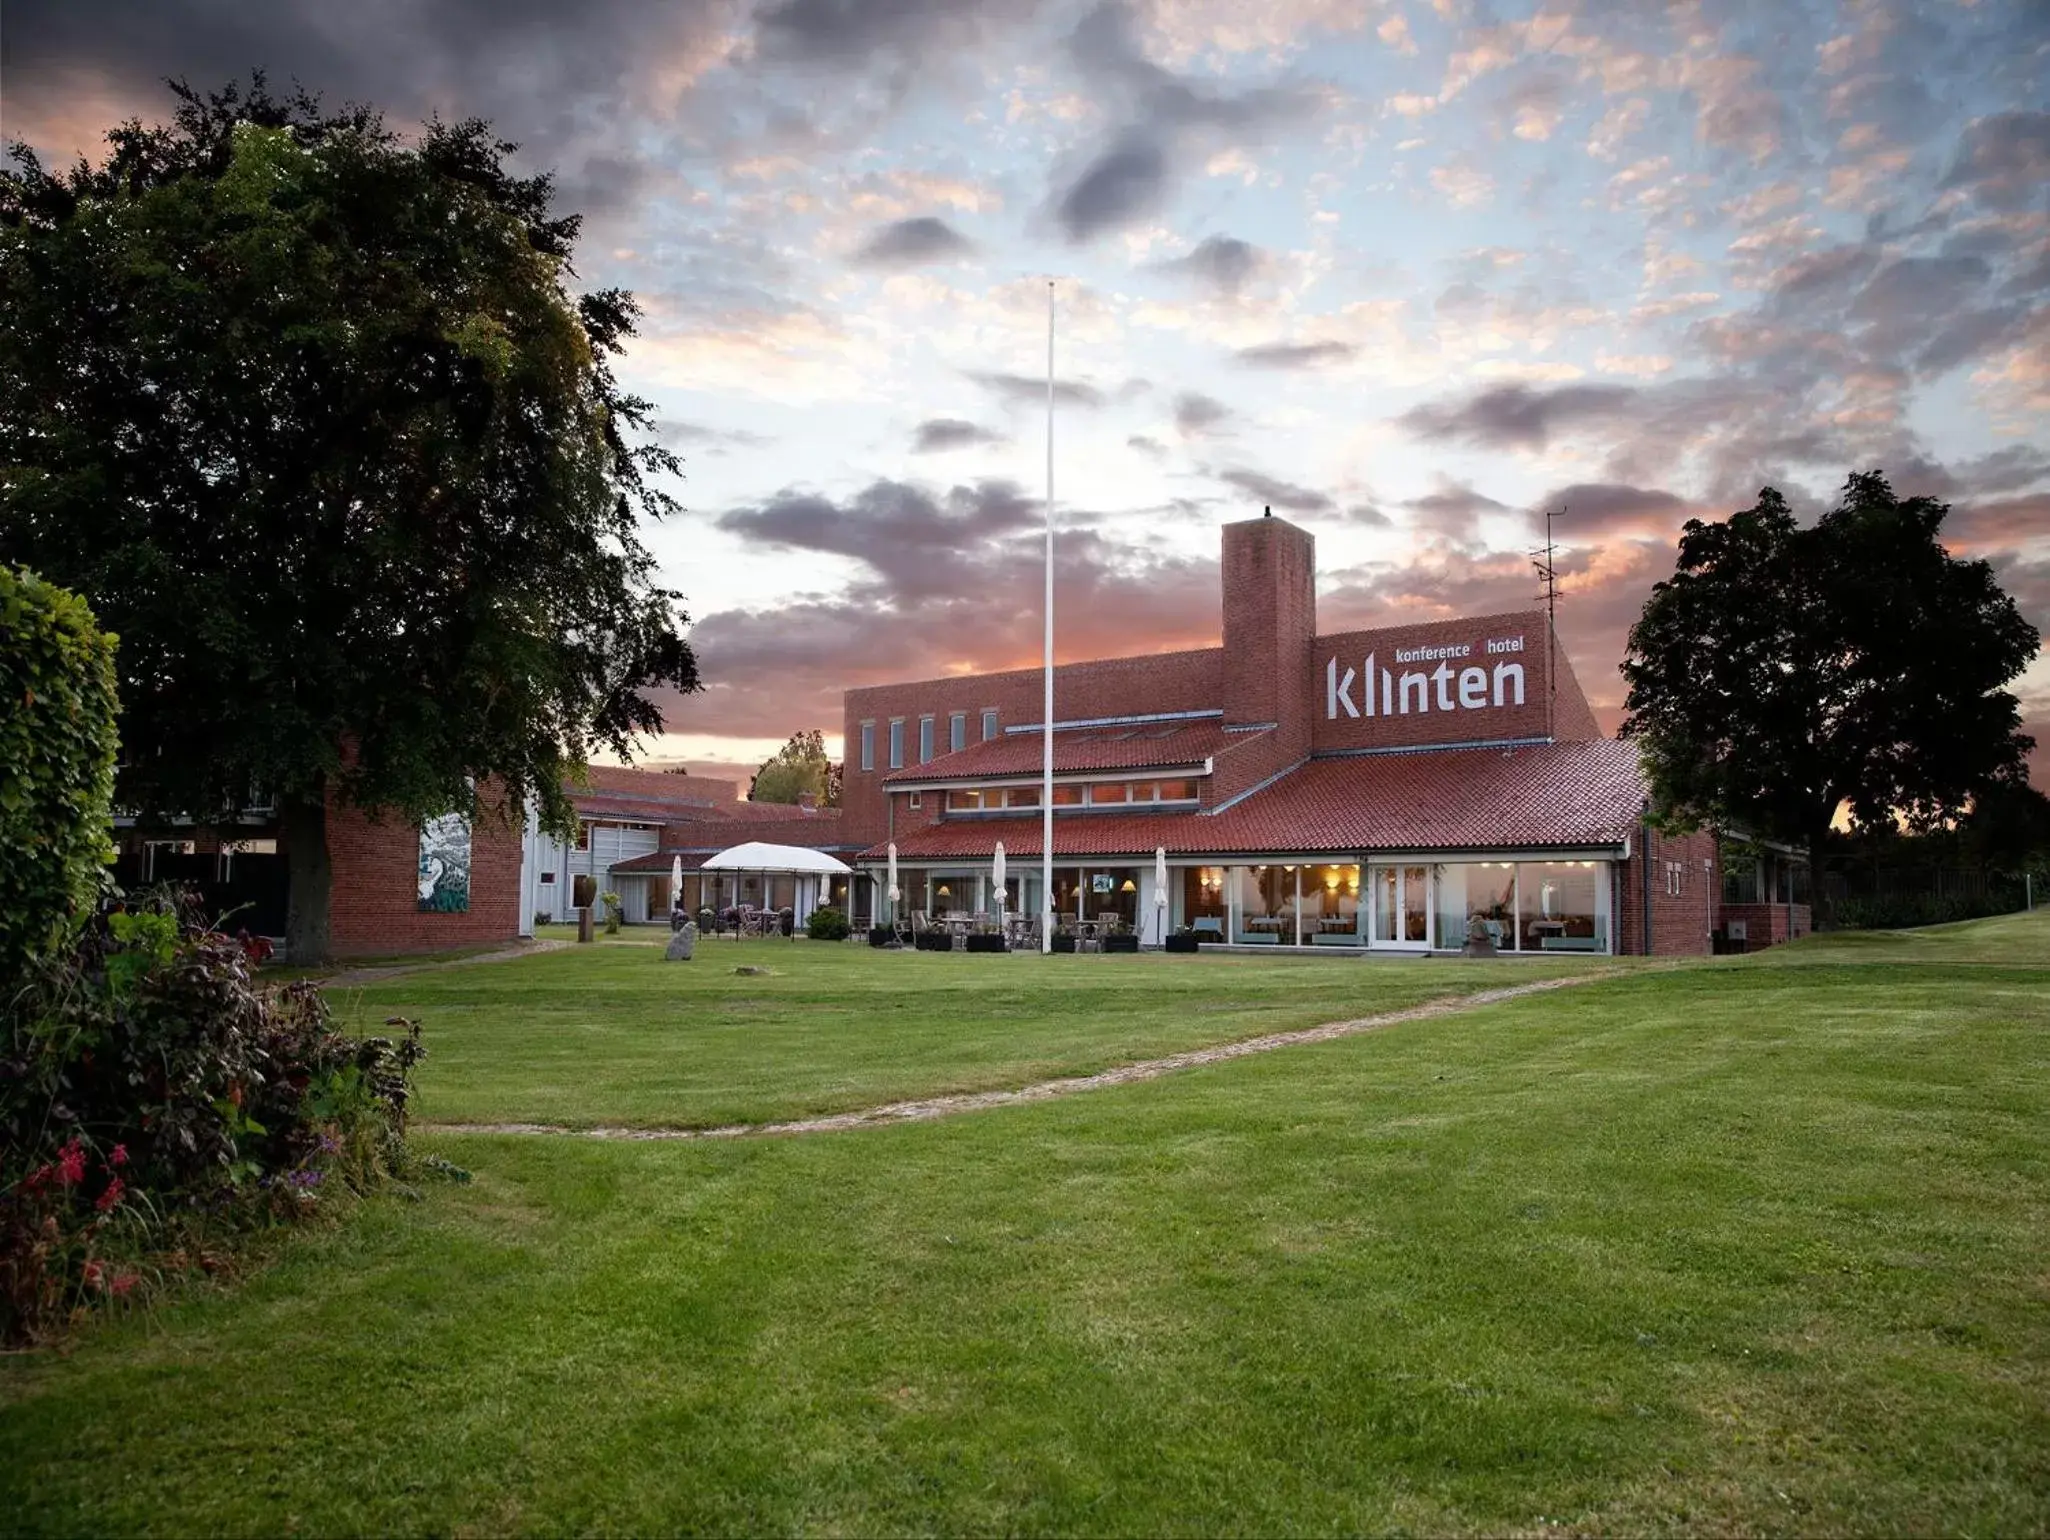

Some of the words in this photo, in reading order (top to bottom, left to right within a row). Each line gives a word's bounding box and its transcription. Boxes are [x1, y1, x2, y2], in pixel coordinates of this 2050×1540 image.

[1396, 645, 1470, 663] konference
[1487, 636, 1524, 654] hotel
[1327, 651, 1525, 720] klinten
